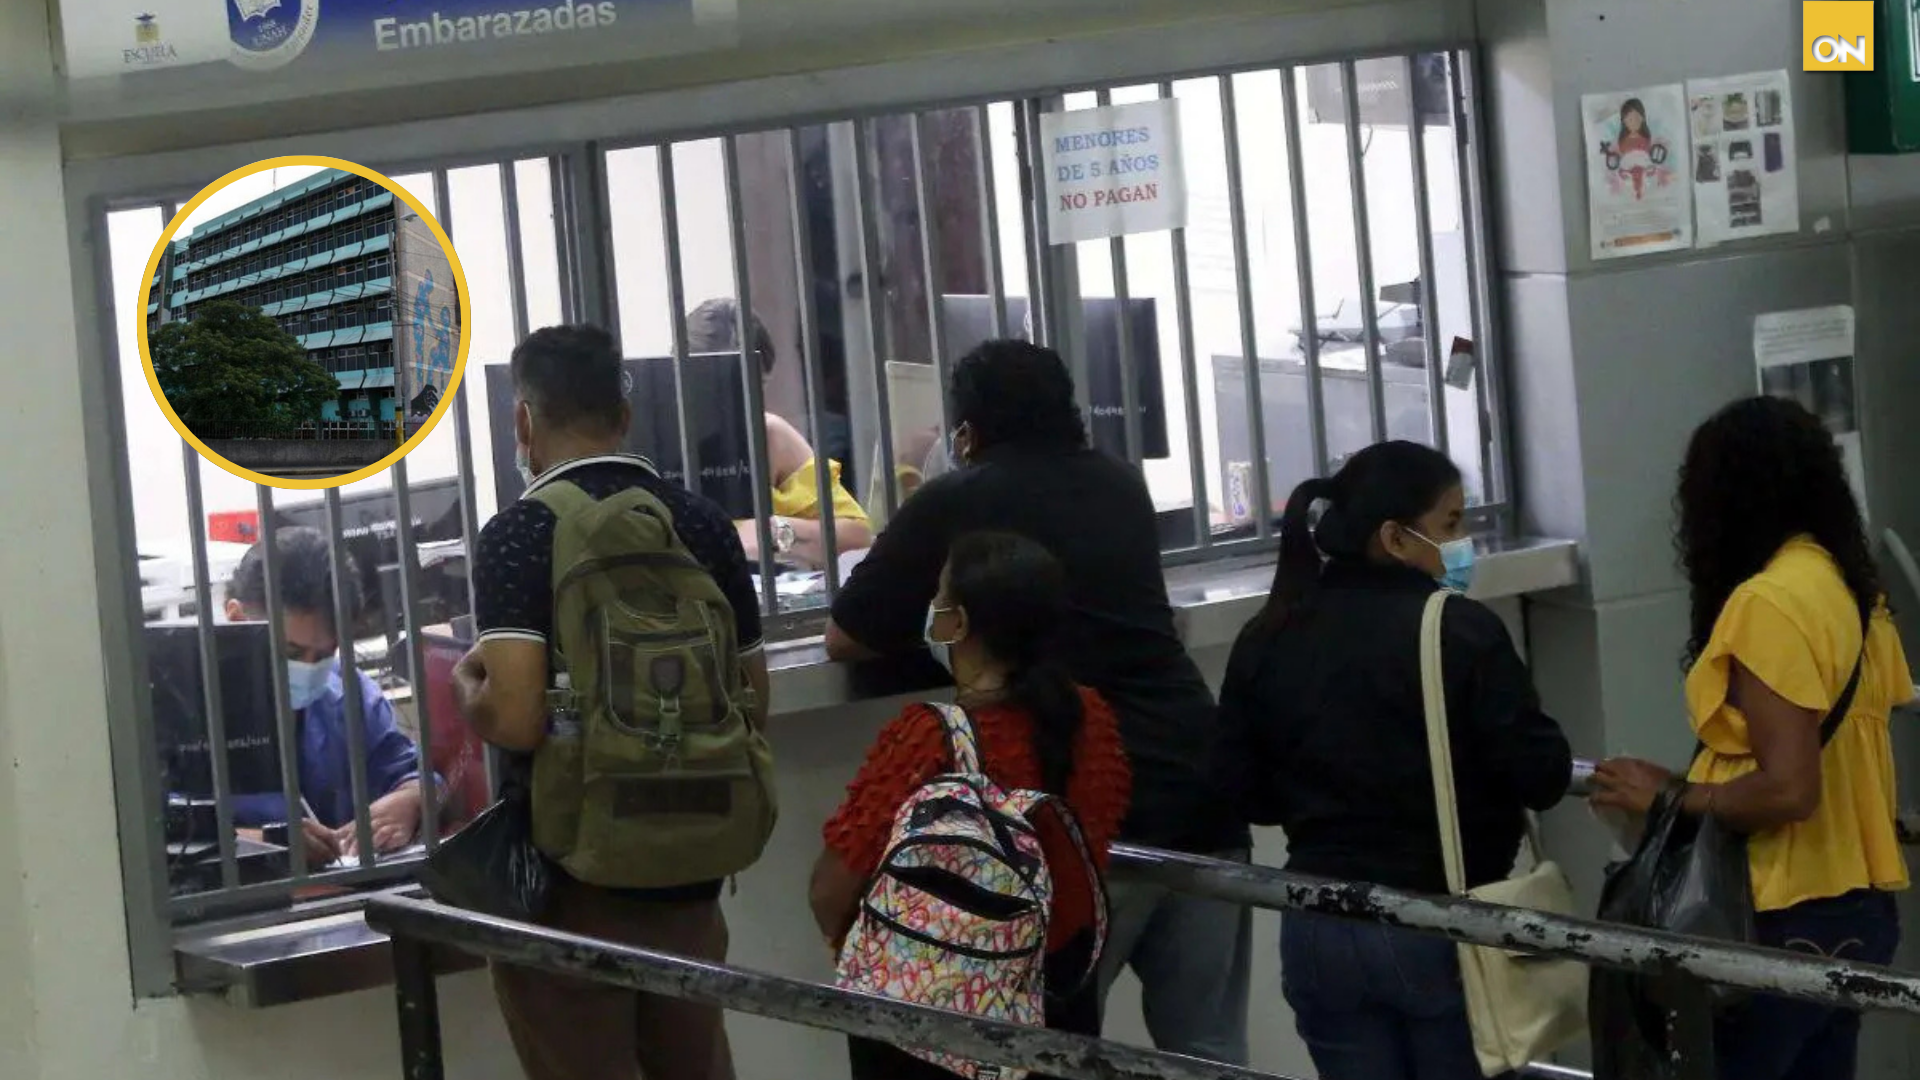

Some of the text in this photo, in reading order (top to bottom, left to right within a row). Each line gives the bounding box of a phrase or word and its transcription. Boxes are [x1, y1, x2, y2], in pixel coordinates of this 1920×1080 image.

[374, 0, 616, 50] Embarazadas
[1055, 127, 1150, 153] MENORES
[1058, 154, 1159, 182] DE 5 AÑOS
[1060, 183, 1158, 211] NO PAGAN
